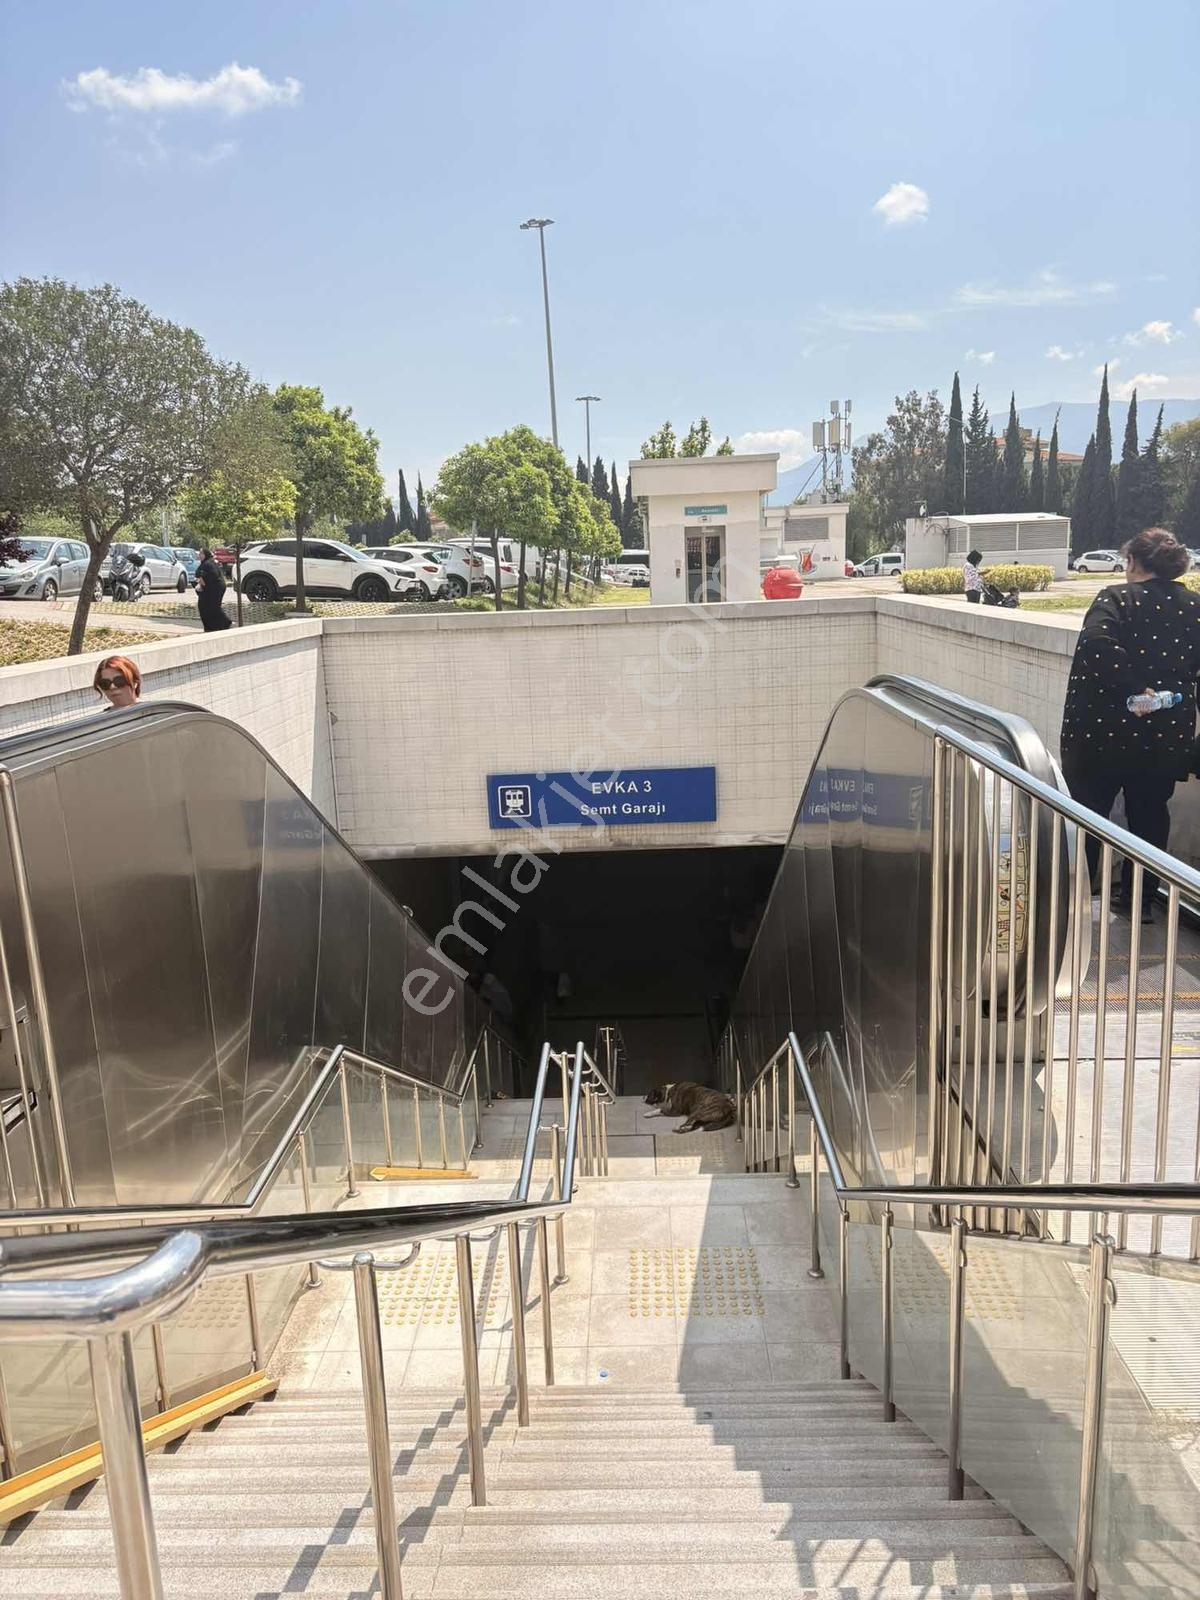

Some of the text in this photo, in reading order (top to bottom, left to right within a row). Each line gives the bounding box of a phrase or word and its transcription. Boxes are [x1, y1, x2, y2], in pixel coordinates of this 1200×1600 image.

[592, 780, 652, 794] EVKA 3
[580, 802, 665, 815] Semt Garajı
